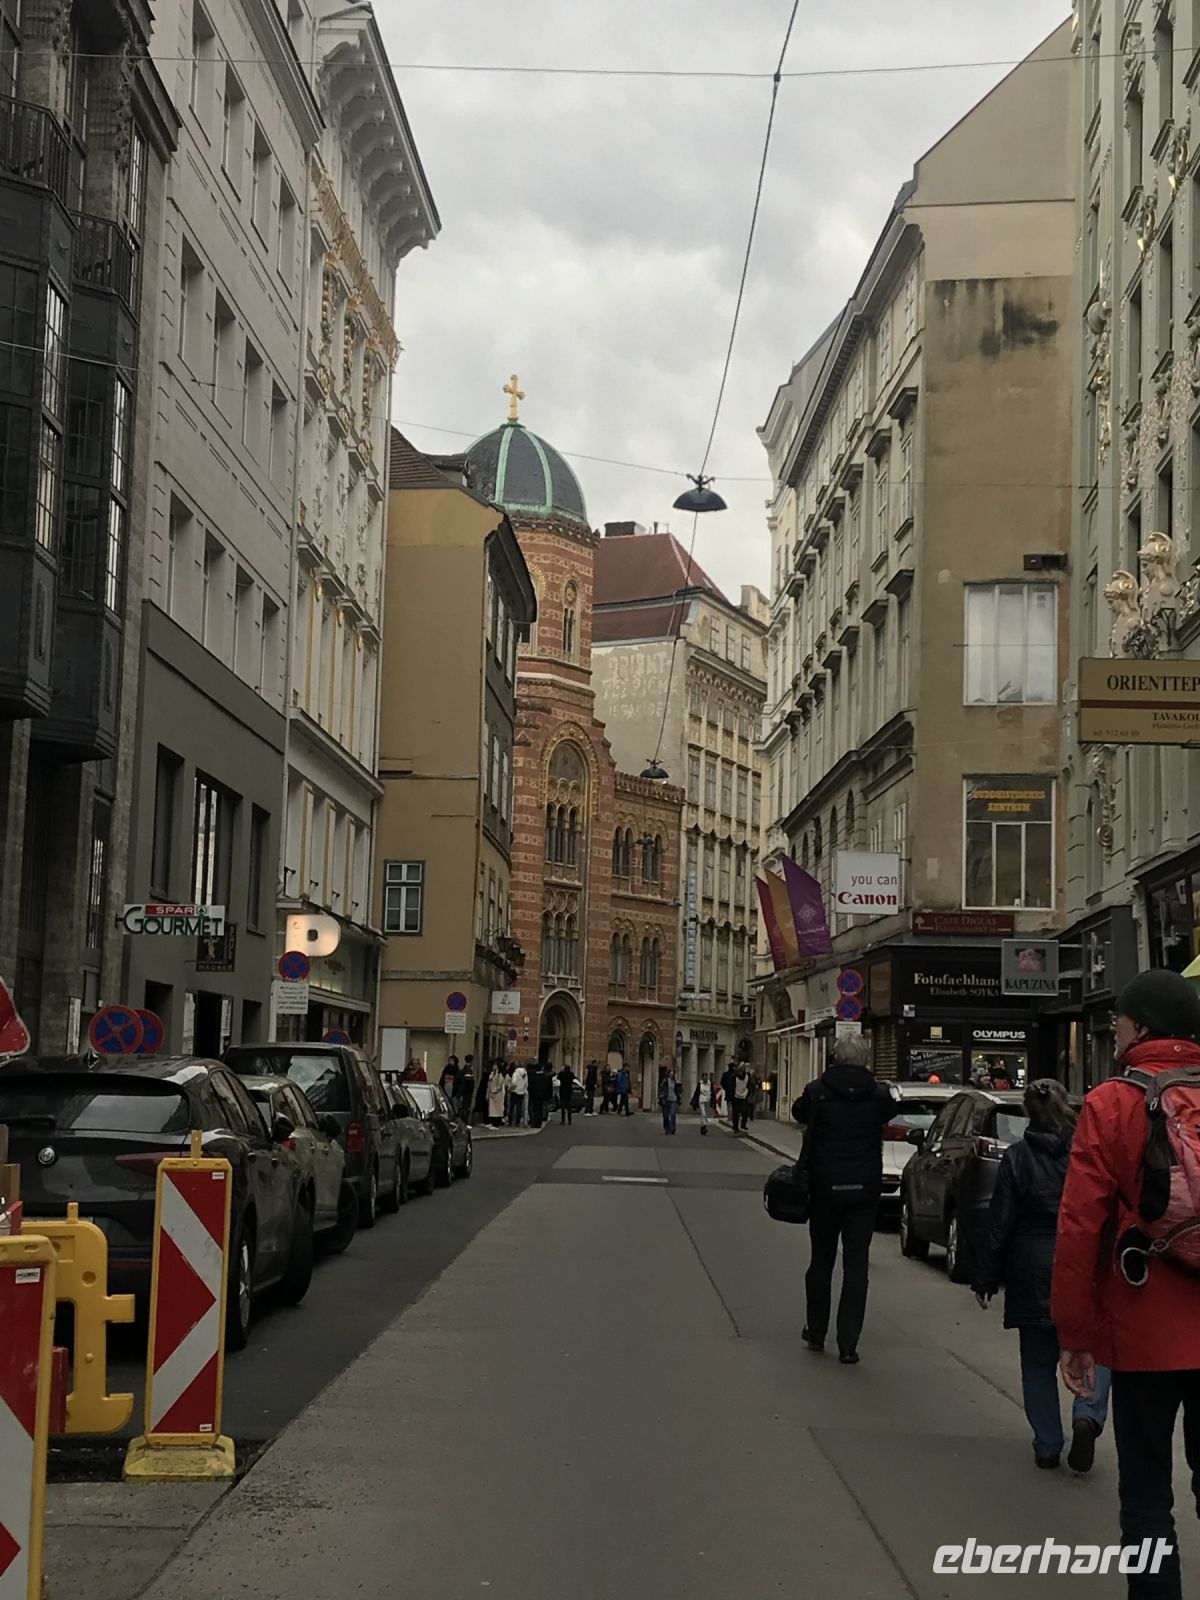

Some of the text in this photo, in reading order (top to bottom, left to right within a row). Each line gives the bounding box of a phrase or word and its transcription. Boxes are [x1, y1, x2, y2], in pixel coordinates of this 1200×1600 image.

[851, 875, 897, 887] you can
[838, 891, 897, 905] Canon
[156, 907, 194, 915] SPAR
[972, 1030, 1027, 1039] OLYMPUS
